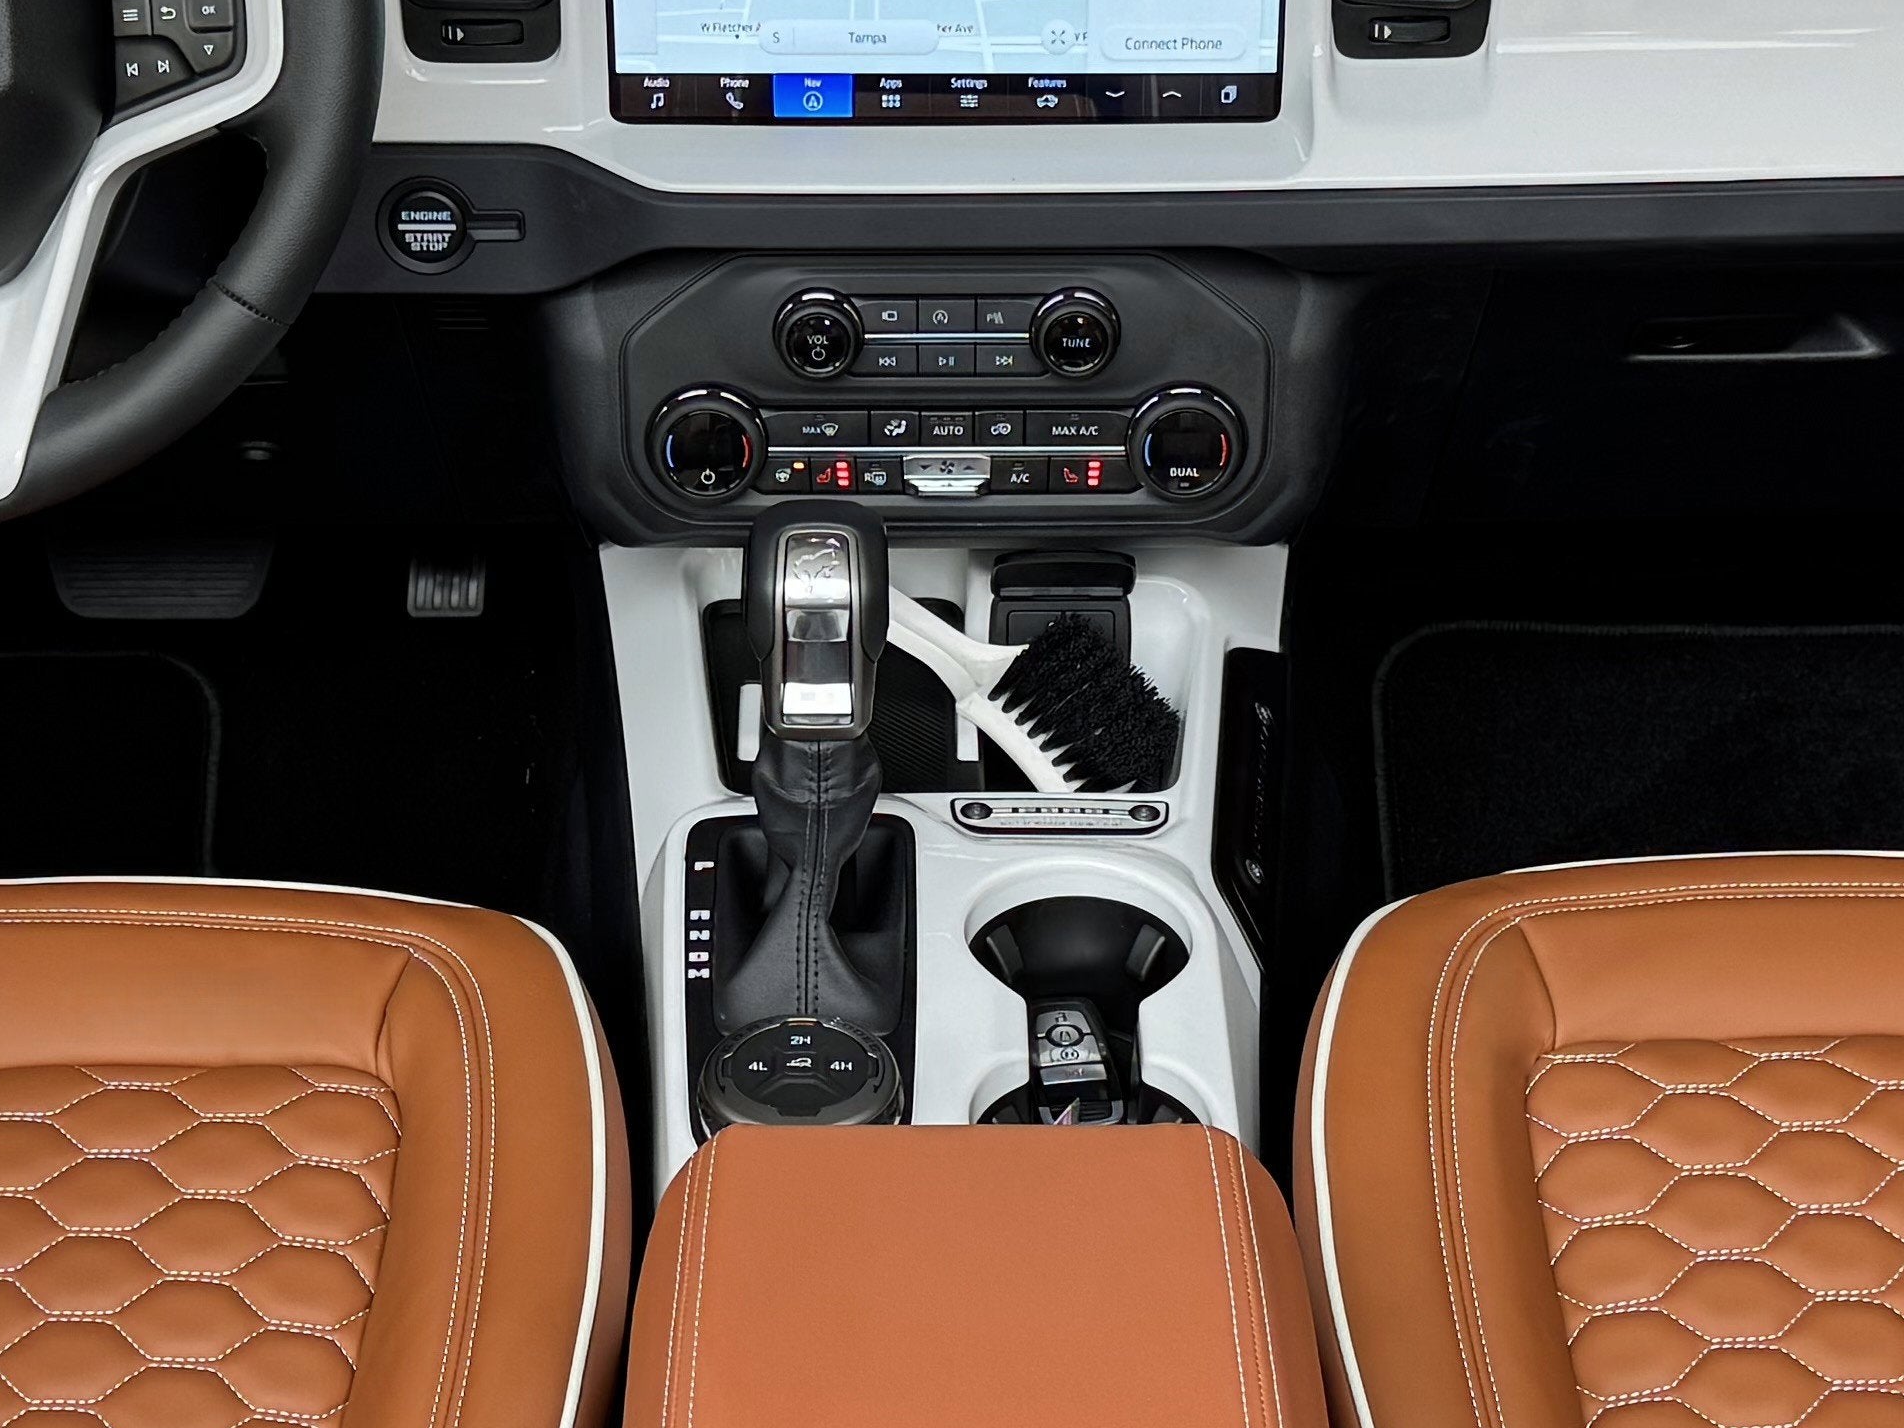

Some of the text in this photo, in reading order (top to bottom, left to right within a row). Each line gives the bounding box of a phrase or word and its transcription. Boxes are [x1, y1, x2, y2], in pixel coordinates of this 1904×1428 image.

[201, 5, 216, 15] OK
[712, 22, 753, 32] Fletcher
[772, 32, 780, 44] S
[848, 32, 887, 46] Tampa
[1125, 37, 1223, 50] Connect Phone
[644, 77, 670, 88] Audio
[720, 77, 749, 88] Phone
[804, 77, 822, 88] Nav
[879, 77, 902, 91] Apps
[950, 77, 988, 91] Settings
[1028, 77, 1067, 88] Features
[401, 211, 451, 221] ENGINE
[405, 232, 452, 243] START
[411, 242, 448, 252] STOP
[807, 335, 829, 346] VOL
[1062, 337, 1091, 349] TUNE
[802, 425, 822, 435] MAX
[932, 424, 964, 435] AUTO
[1052, 423, 1099, 436] MAX A/C
[1010, 472, 1030, 484] A/C
[1169, 467, 1199, 478] DUAL
[694, 861, 715, 871] P
[690, 910, 710, 920] R
[689, 930, 710, 940] N
[688, 951, 709, 962] D
[687, 968, 710, 979] M
[790, 1036, 811, 1045] 2H
[748, 1061, 768, 1071] 4L
[830, 1061, 853, 1071] 4H
